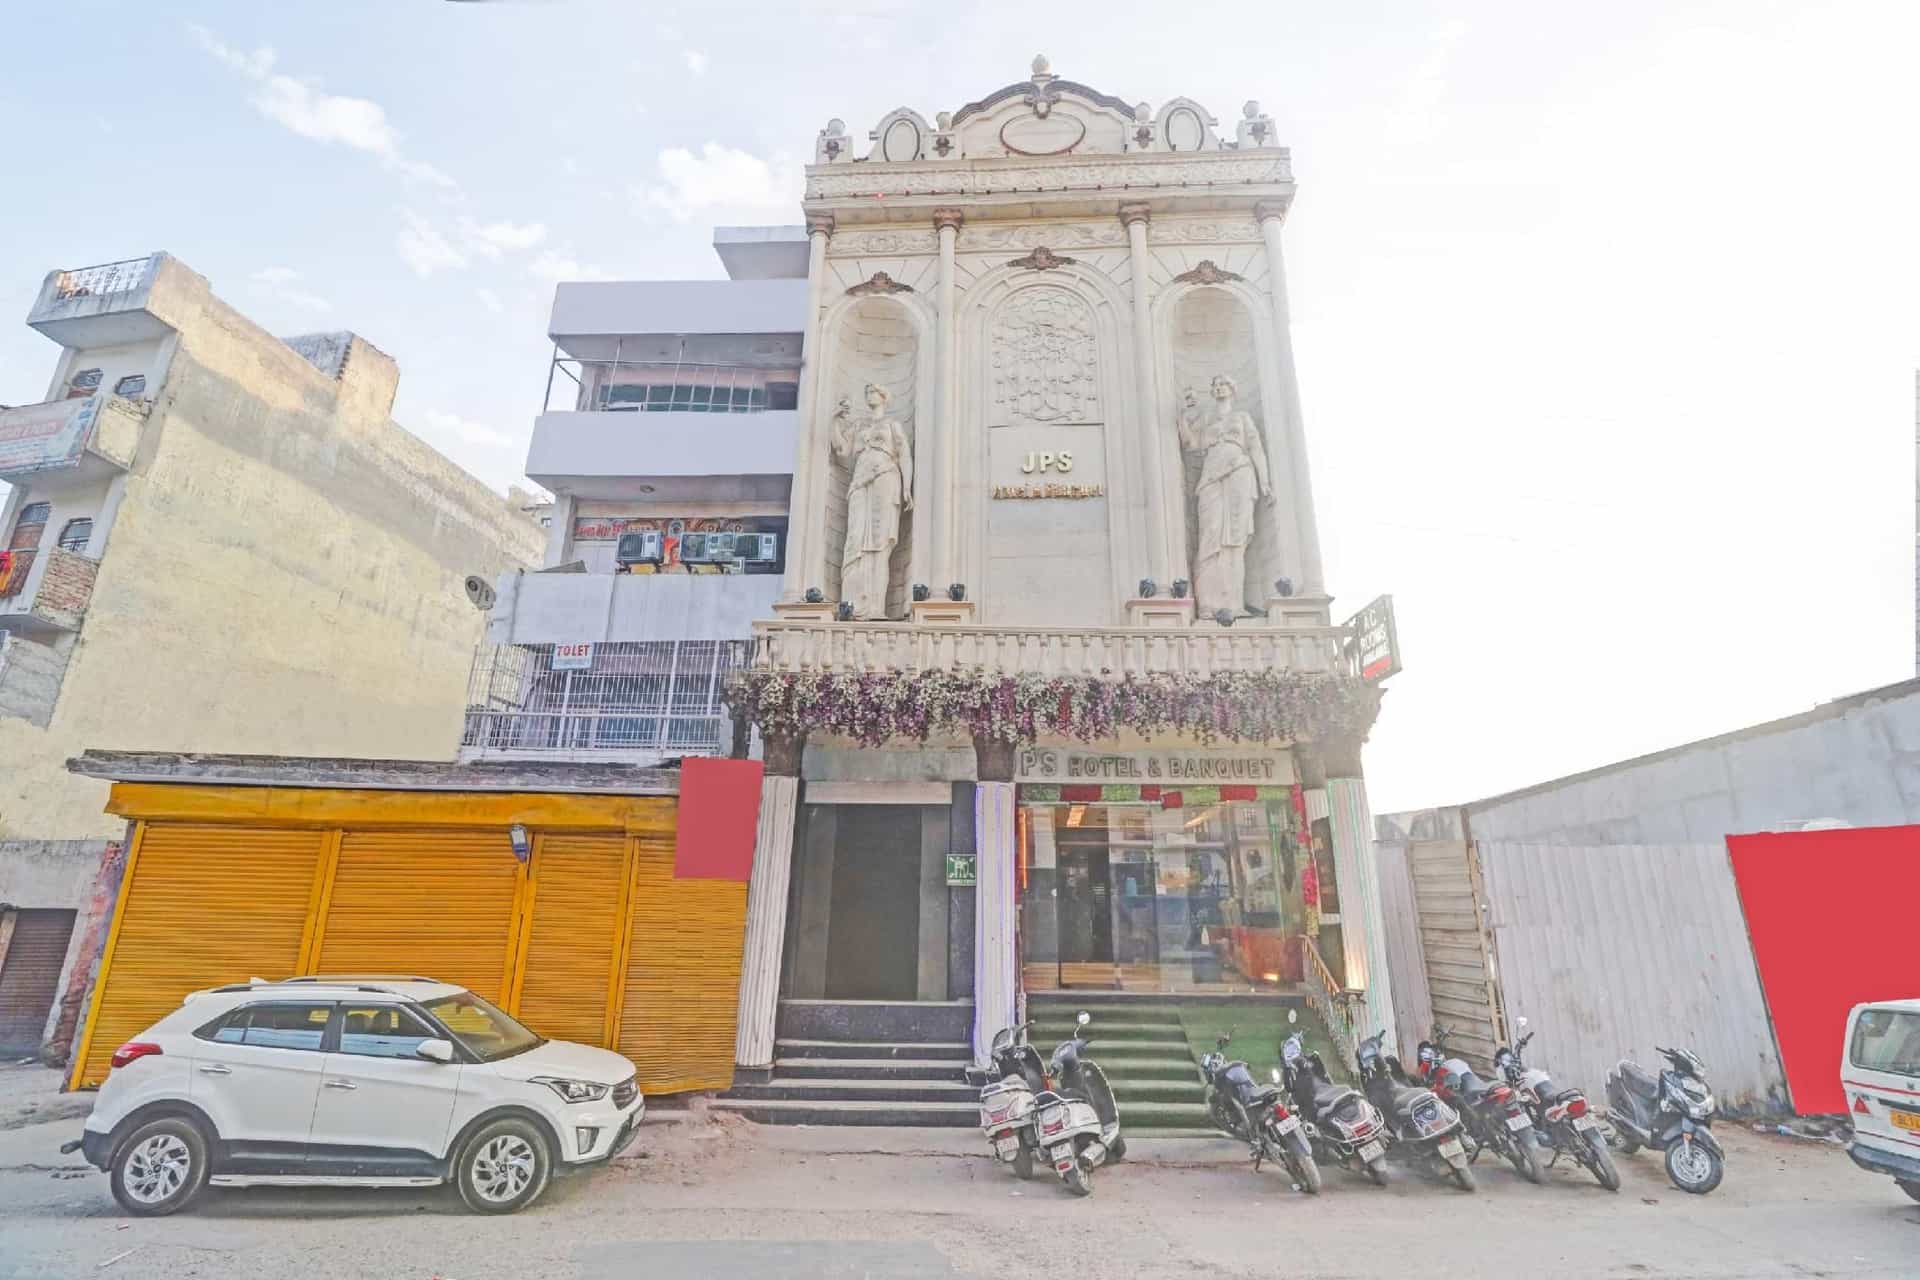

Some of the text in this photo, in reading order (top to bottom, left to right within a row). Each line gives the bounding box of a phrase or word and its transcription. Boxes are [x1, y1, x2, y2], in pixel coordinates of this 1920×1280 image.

[1021, 450, 1074, 473] JPS
[1067, 755, 1141, 778] HOTEL
[1147, 756, 1162, 778] &
[1168, 756, 1276, 779] BANQUET
